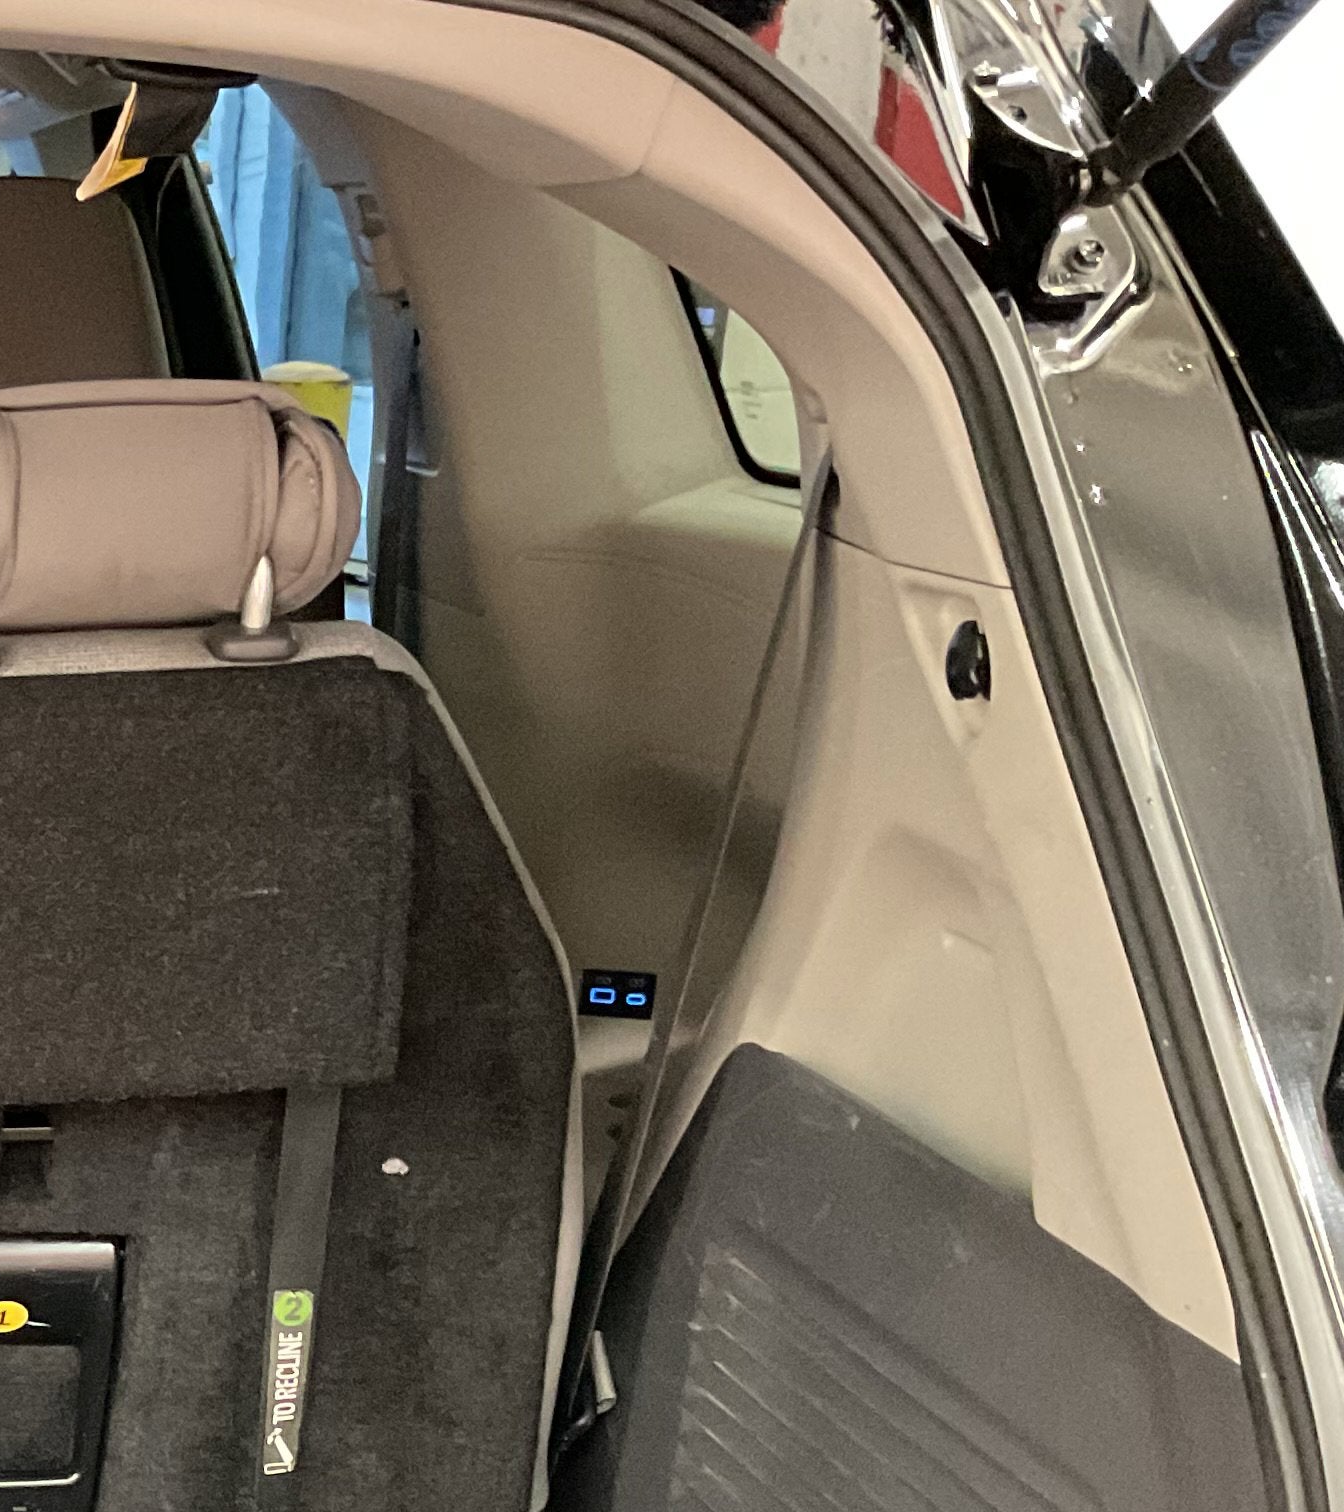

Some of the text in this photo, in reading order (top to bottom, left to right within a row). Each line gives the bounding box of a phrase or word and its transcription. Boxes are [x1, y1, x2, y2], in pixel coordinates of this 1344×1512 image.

[284, 1296, 303, 1321] 2
[272, 1331, 303, 1425] TO RECLINE
